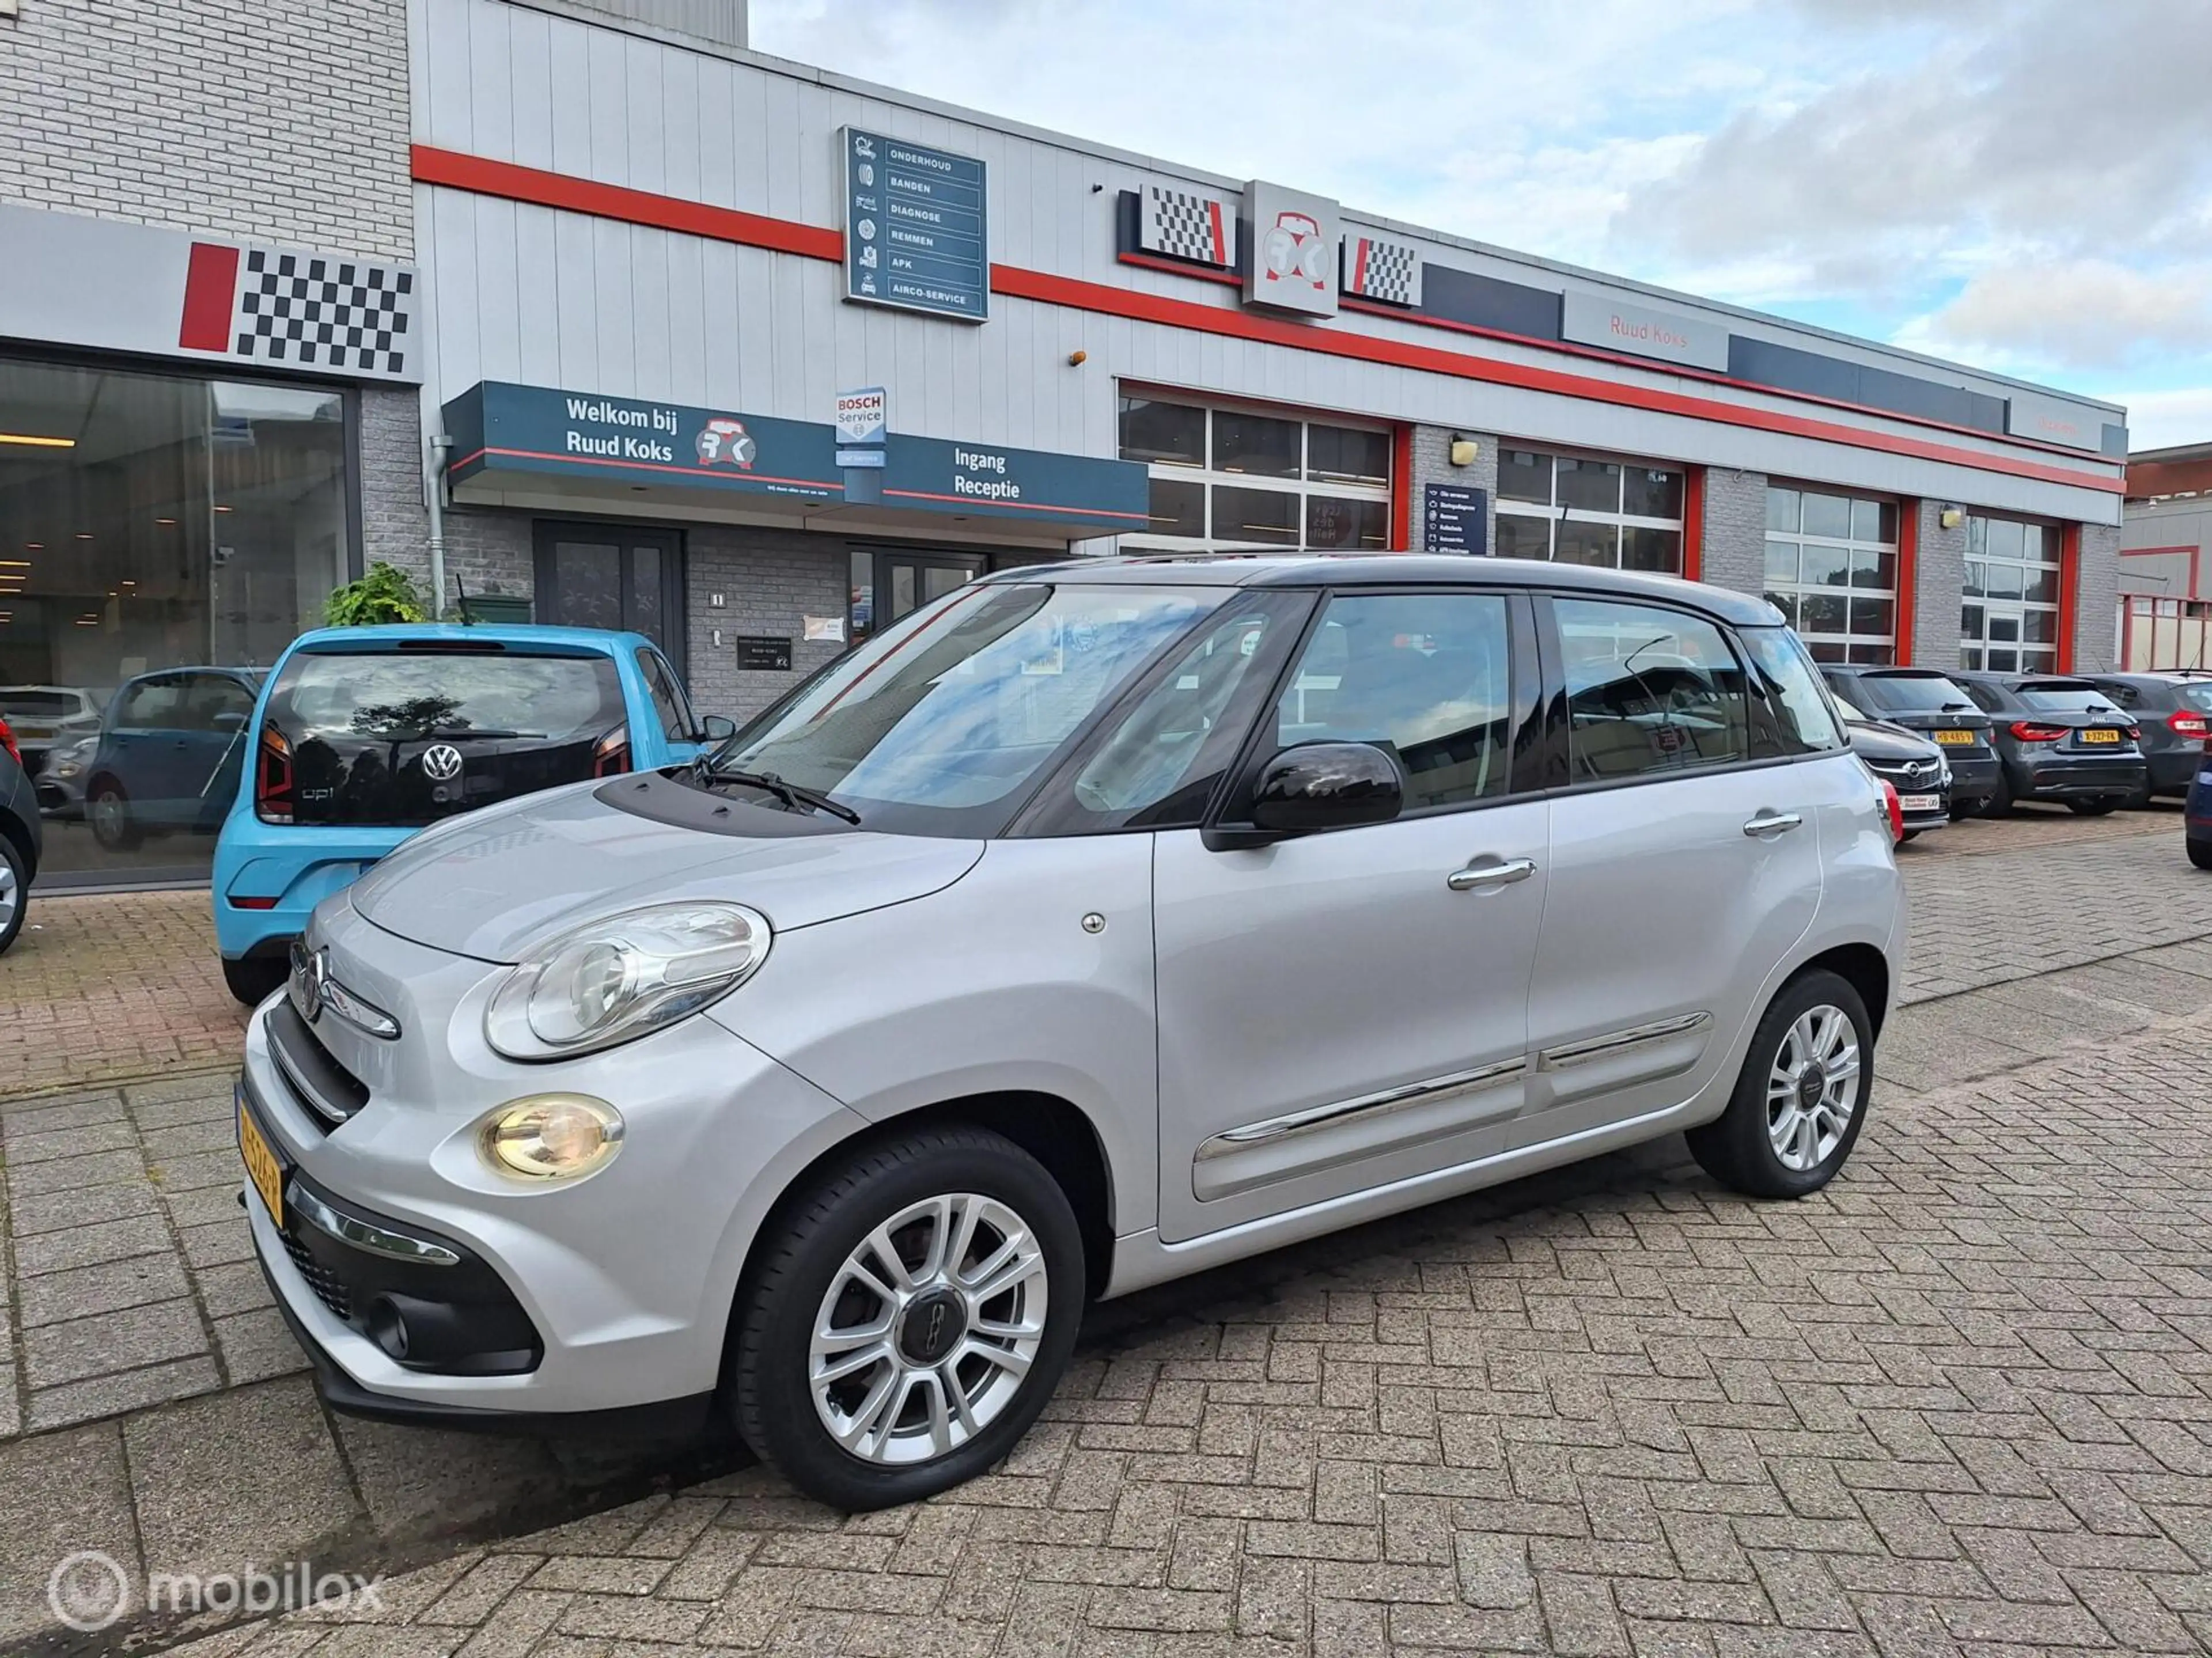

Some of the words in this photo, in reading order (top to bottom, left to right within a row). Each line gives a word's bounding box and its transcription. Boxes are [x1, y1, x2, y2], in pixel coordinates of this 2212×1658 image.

[890, 149, 951, 171] ONDERHOUD
[891, 177, 931, 194] BANDEN
[891, 204, 941, 223] DIAGNOSE
[891, 230, 934, 247] REMMEN
[892, 258, 912, 270] APK
[892, 283, 967, 305] AIRCO-SERVICE
[1610, 315, 1648, 340] Ruud
[1653, 324, 1688, 348] Koks
[838, 396, 881, 411] BOSCH
[566, 398, 650, 429] Welkom
[652, 407, 678, 436] bij
[838, 410, 881, 423] Service
[566, 431, 622, 457] Ruud
[624, 438, 673, 462] Koks
[955, 447, 1006, 474] Ingang
[955, 475, 1020, 500] Receptie
